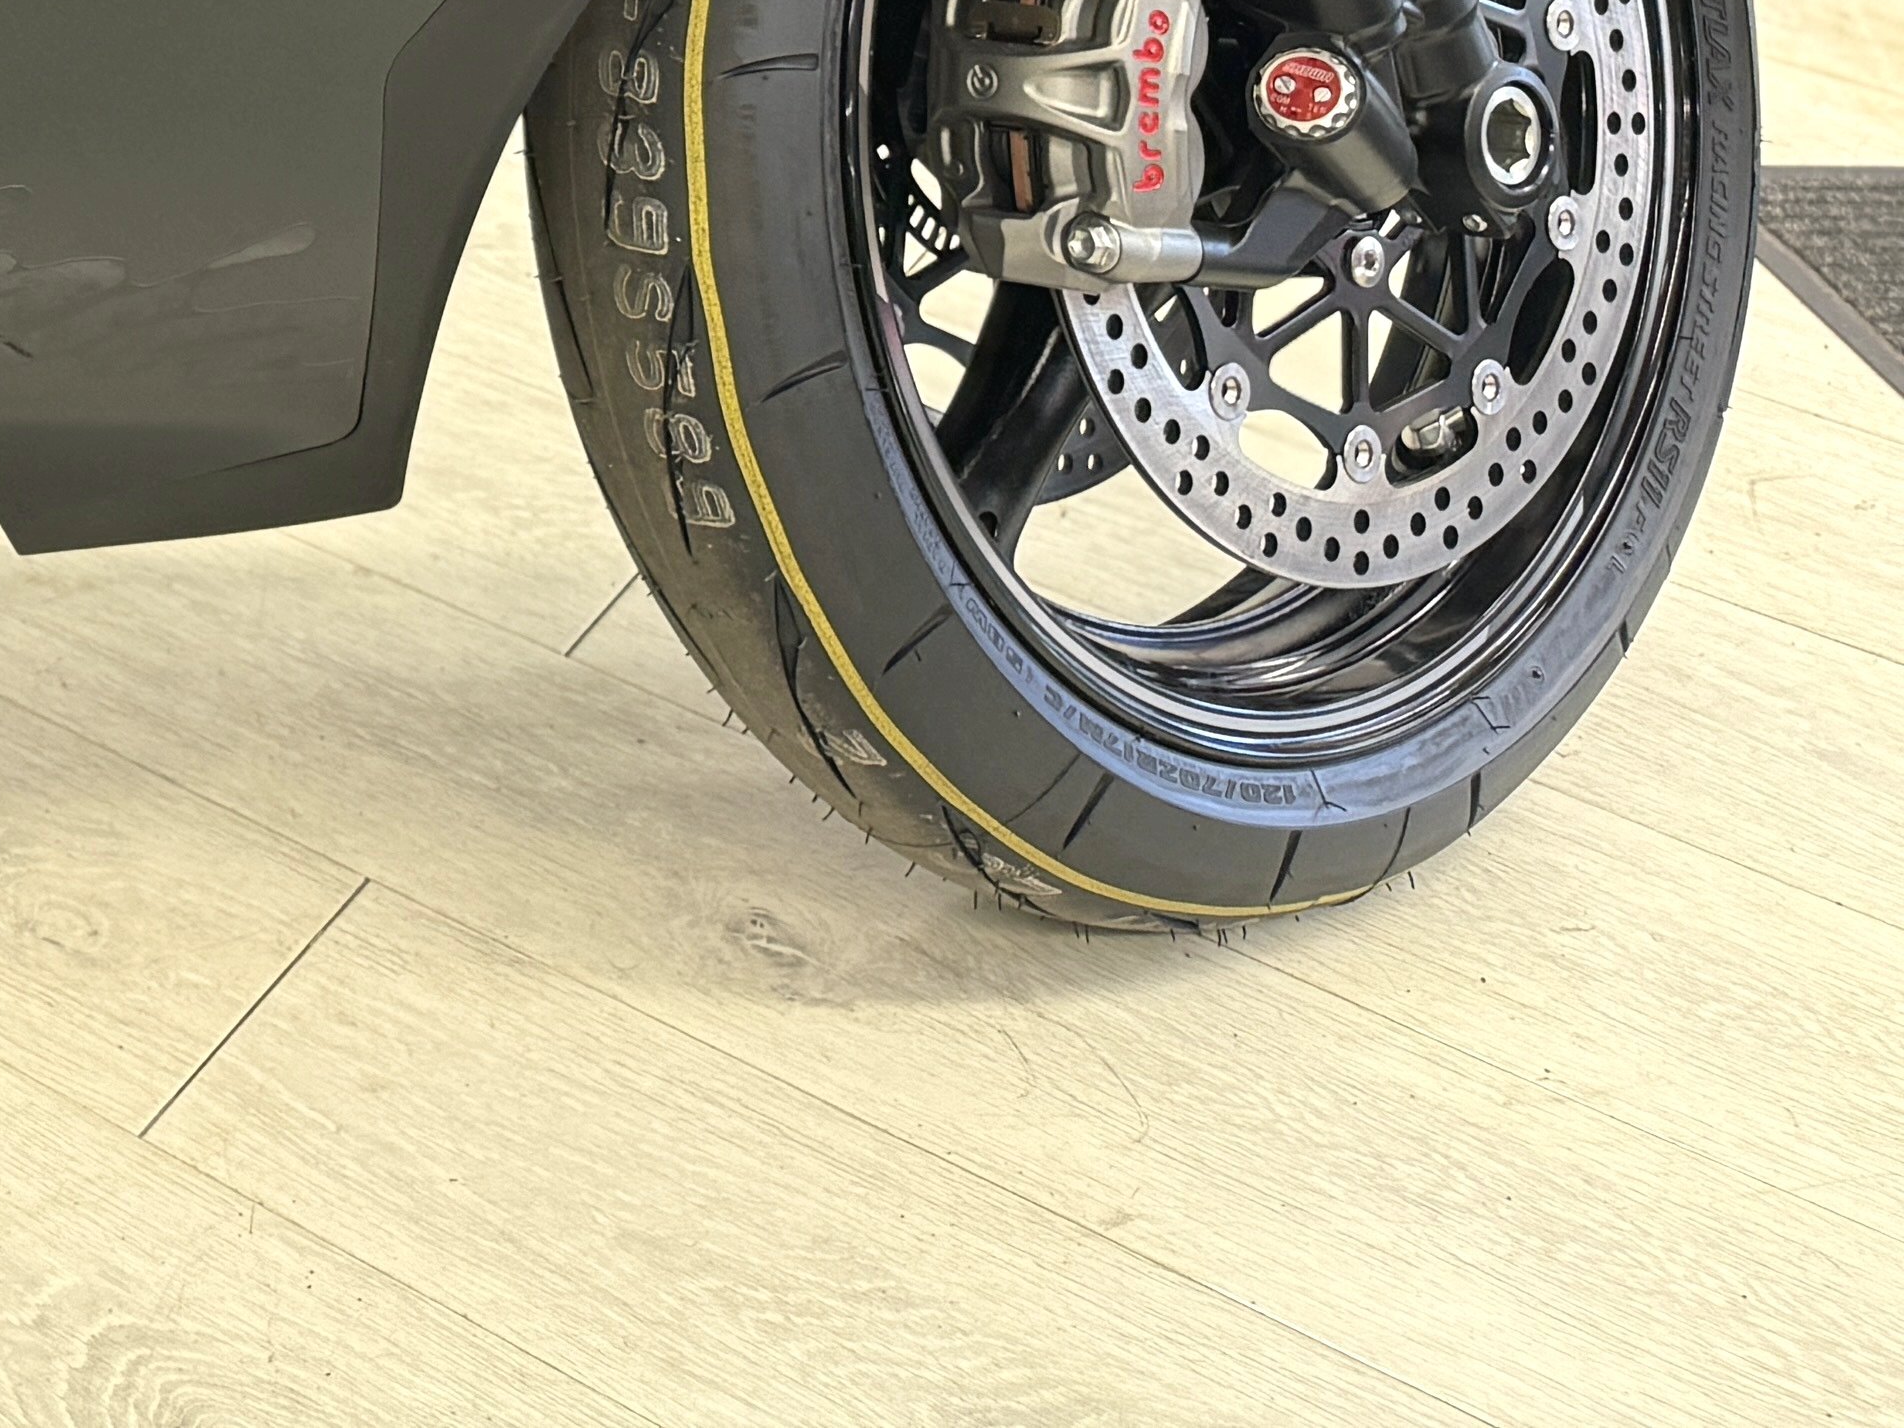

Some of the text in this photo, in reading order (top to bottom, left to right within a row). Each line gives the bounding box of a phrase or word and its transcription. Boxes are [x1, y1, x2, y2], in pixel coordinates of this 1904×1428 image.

[1133, 7, 1172, 194] brembo
[1705, 121, 1731, 258] RACING
[1678, 263, 1723, 402] STREET
[1042, 684, 1298, 808] 120/70ZR17M/C
